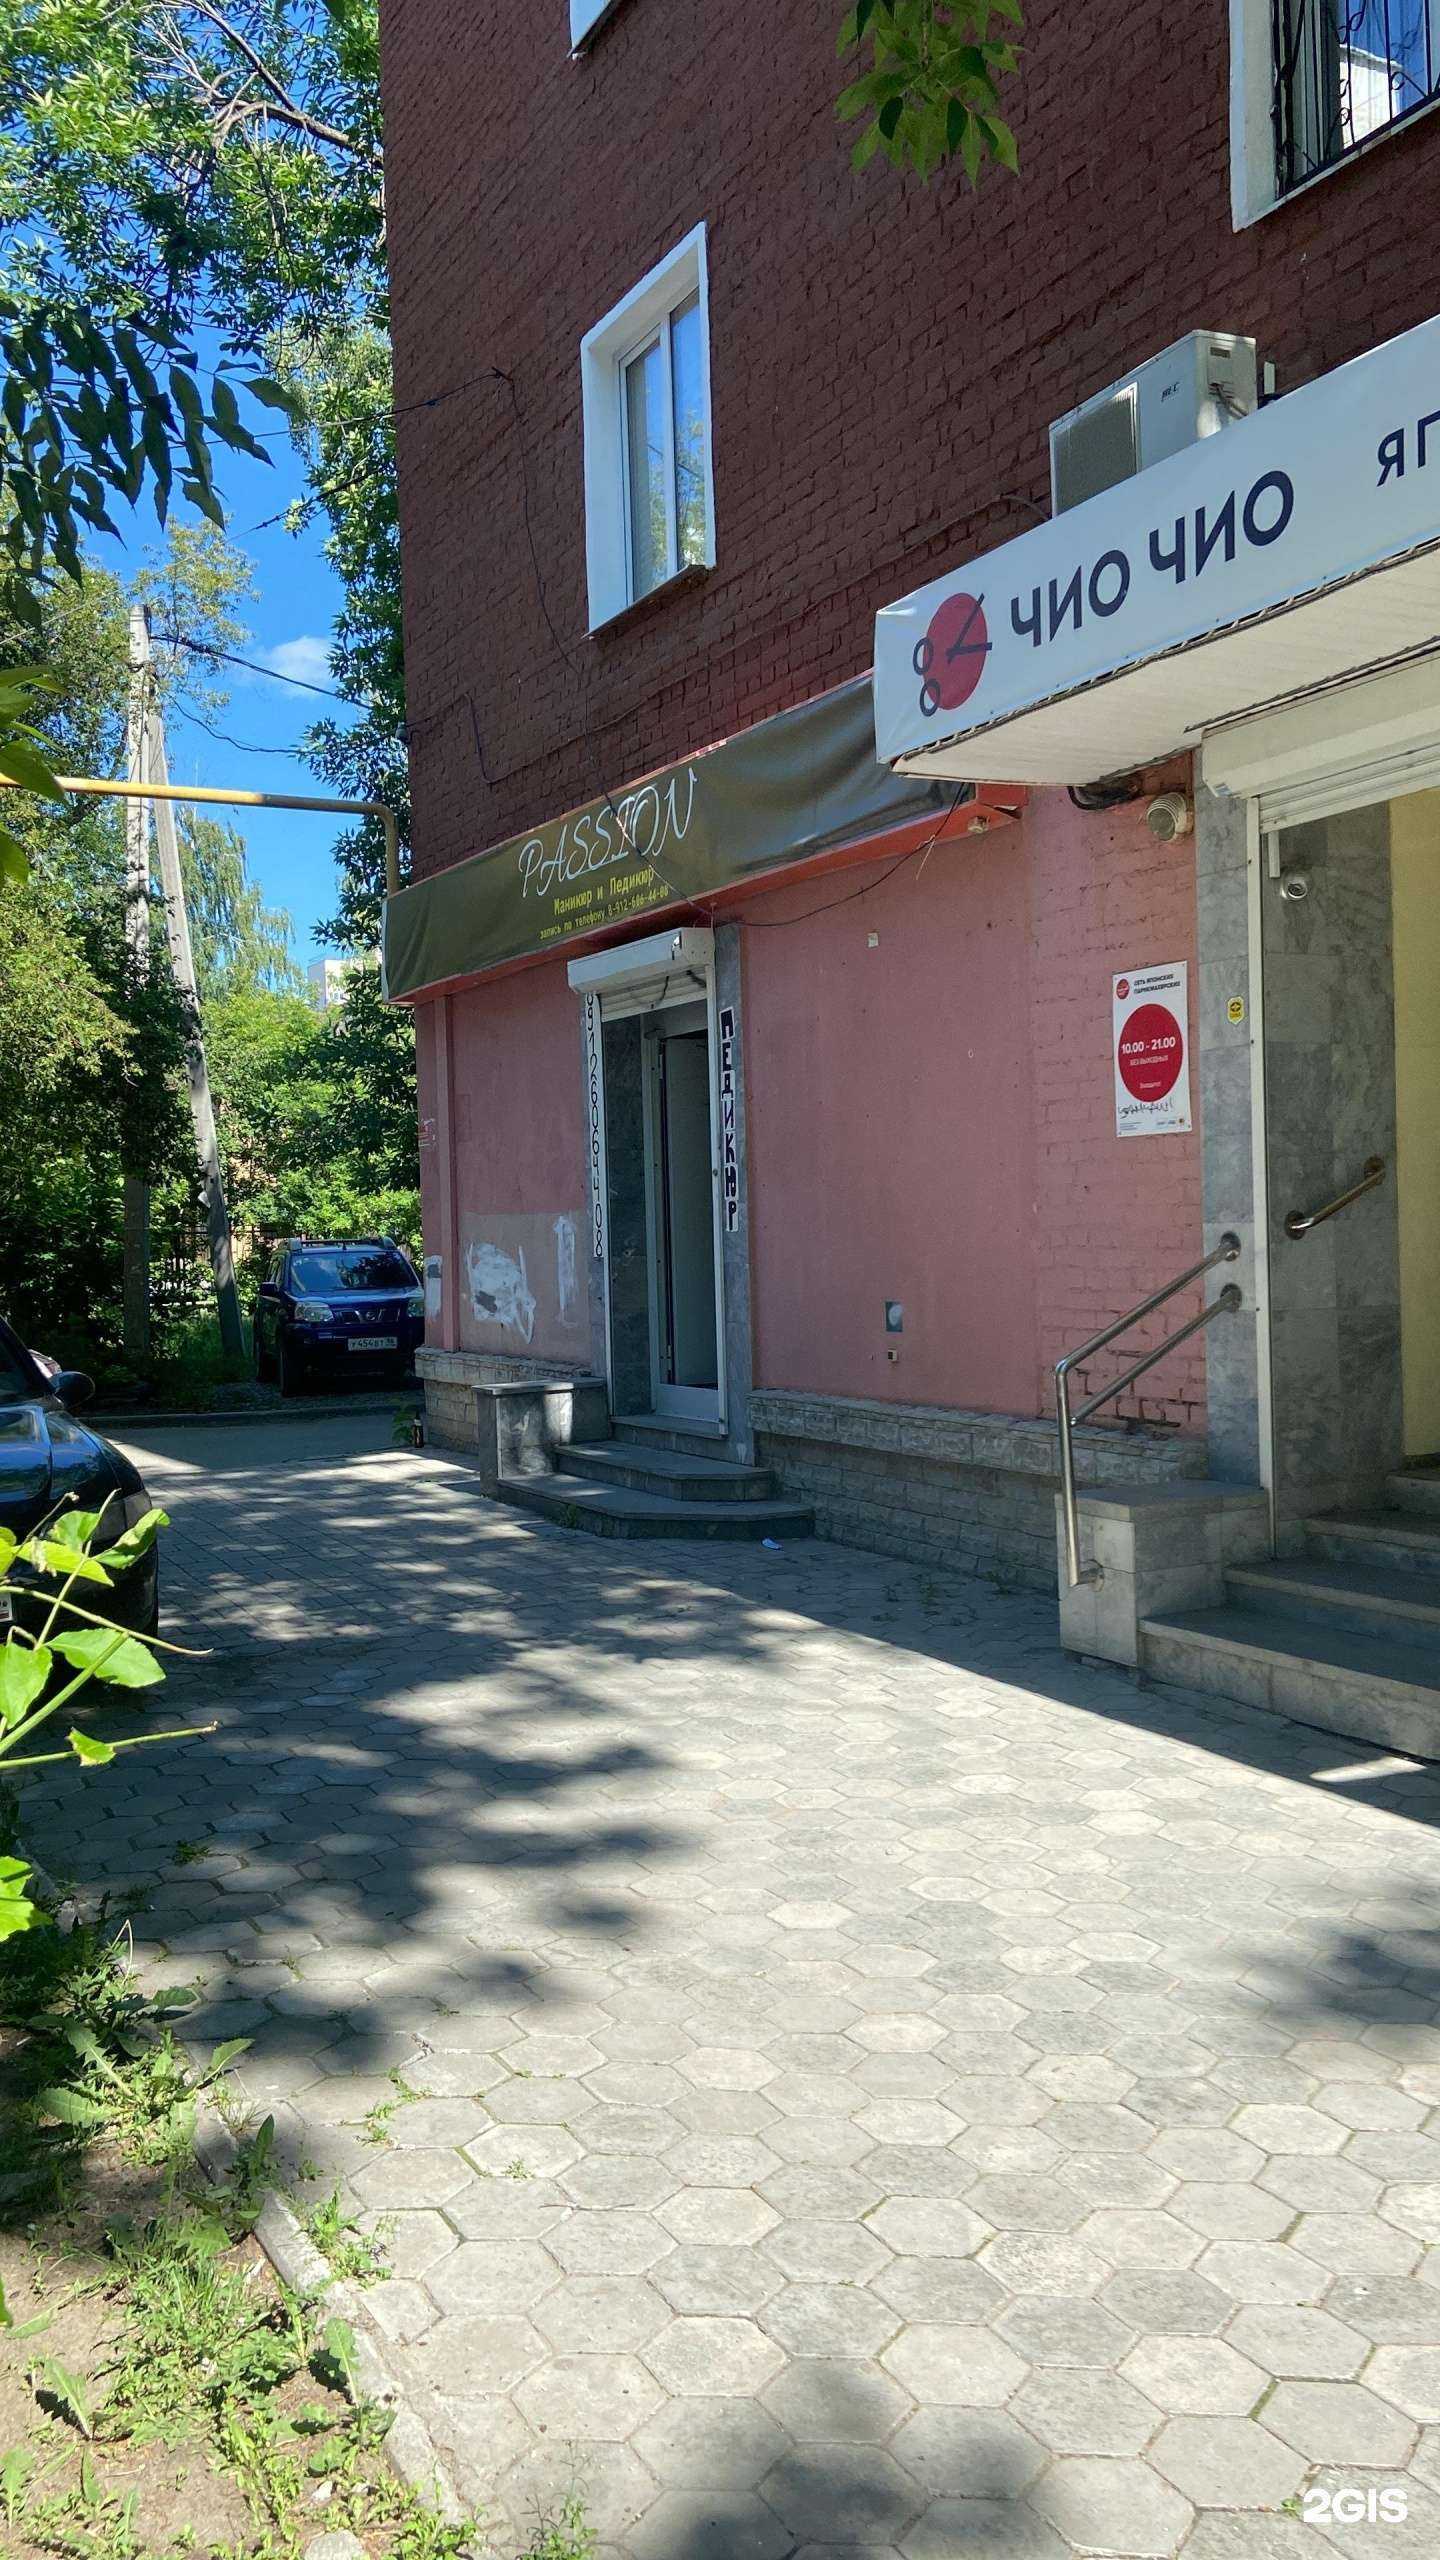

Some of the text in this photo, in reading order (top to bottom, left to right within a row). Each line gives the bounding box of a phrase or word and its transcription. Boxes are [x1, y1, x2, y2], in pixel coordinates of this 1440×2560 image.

[1010, 549, 1131, 647] ЧИО
[1149, 470, 1294, 584] ЧИО
[518, 767, 698, 898] PASSION
[539, 925, 562, 939] запись
[564, 921, 573, 931] по
[575, 910, 605, 926] телефону
[554, 867, 655, 915] Маникюр и Педикюр
[1122, 1041, 1145, 1054] 10.00
[1151, 1037, 1176, 1050] 21.00
[720, 1009, 738, 1232] ПЕДИКЮР
